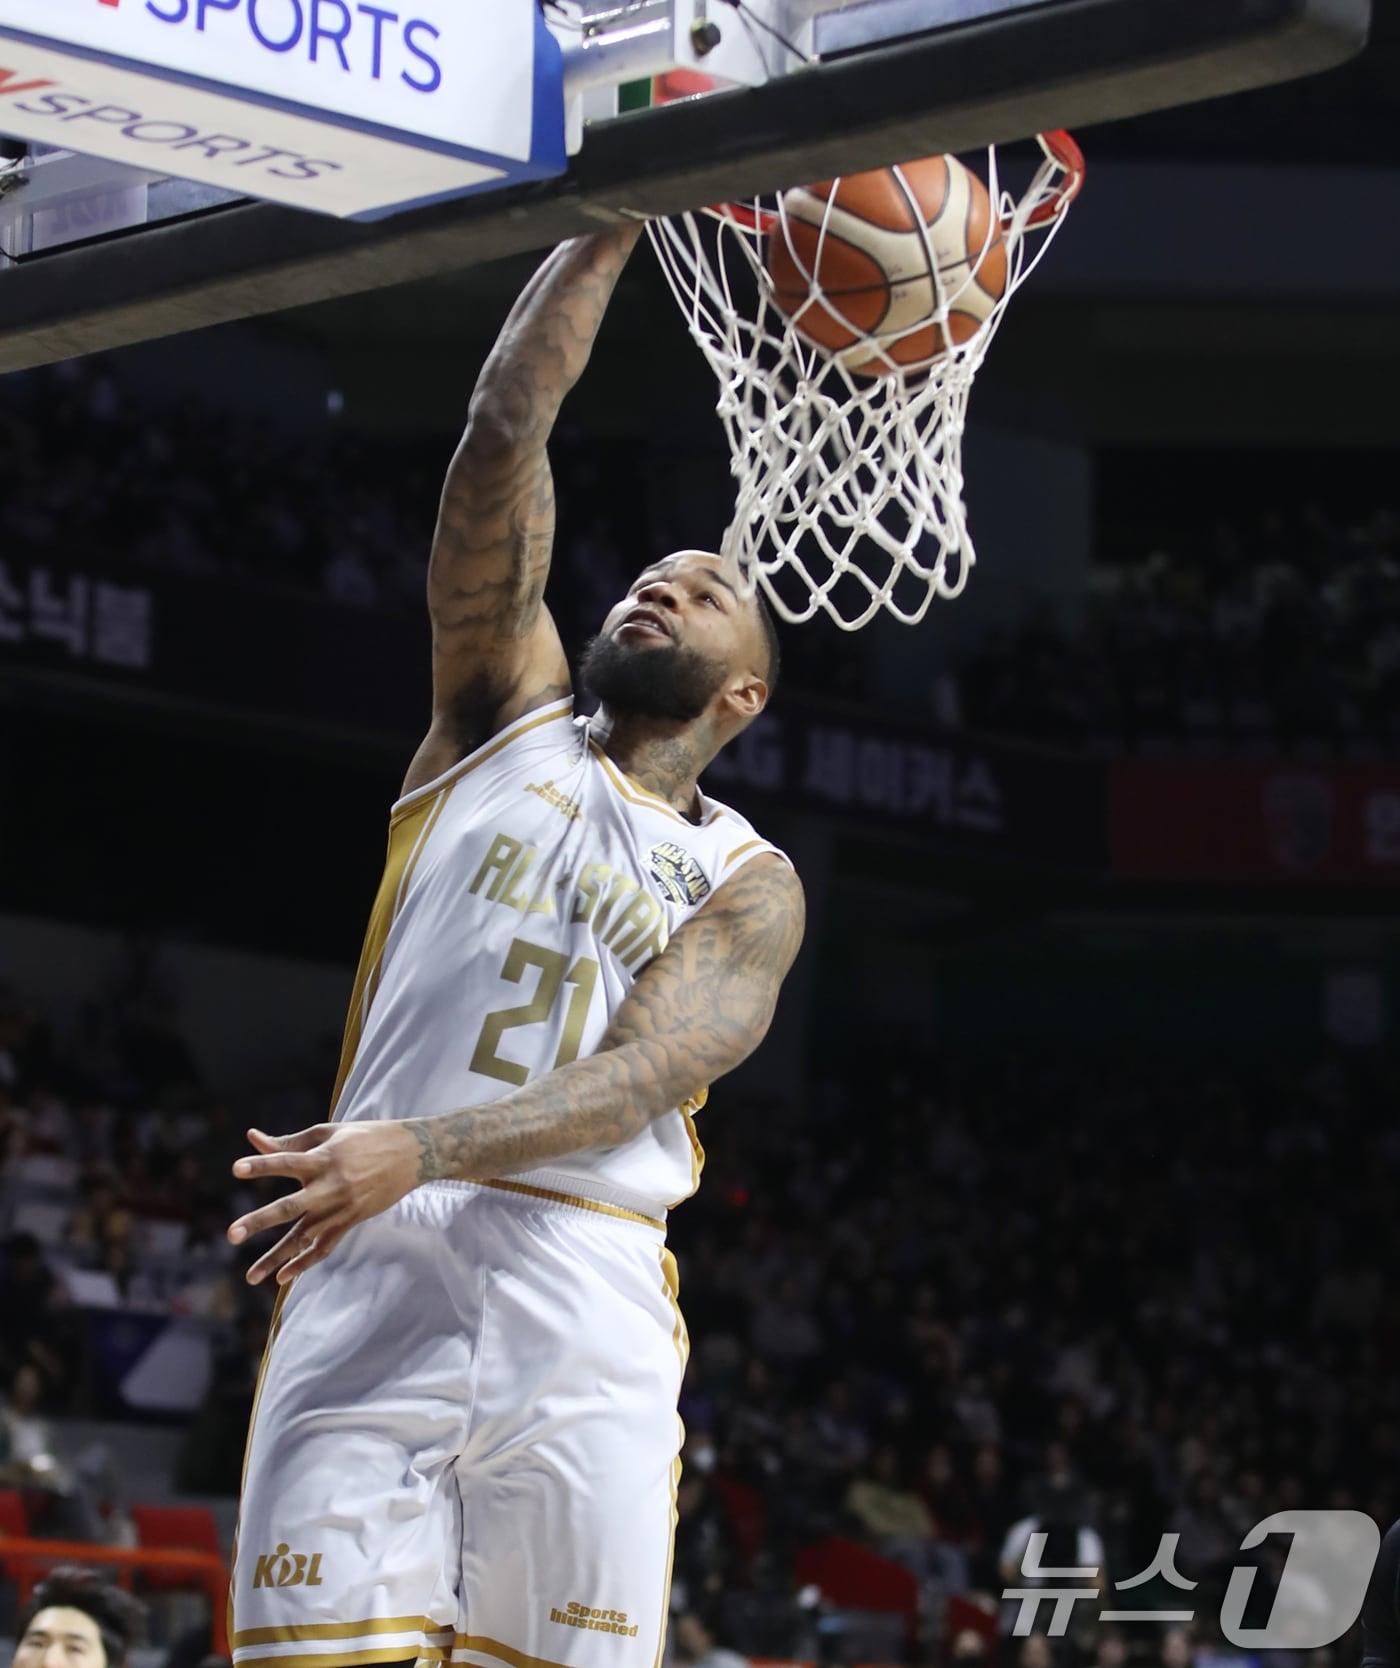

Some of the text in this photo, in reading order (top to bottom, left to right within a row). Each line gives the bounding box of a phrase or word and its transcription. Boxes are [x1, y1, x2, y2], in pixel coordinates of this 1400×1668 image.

[14, 92, 344, 182] SPORTS
[469, 937, 599, 1087] 21
[253, 1543, 323, 1589] KBL
[550, 1608, 639, 1637] Illustrated
[566, 1602, 627, 1623] Sports
